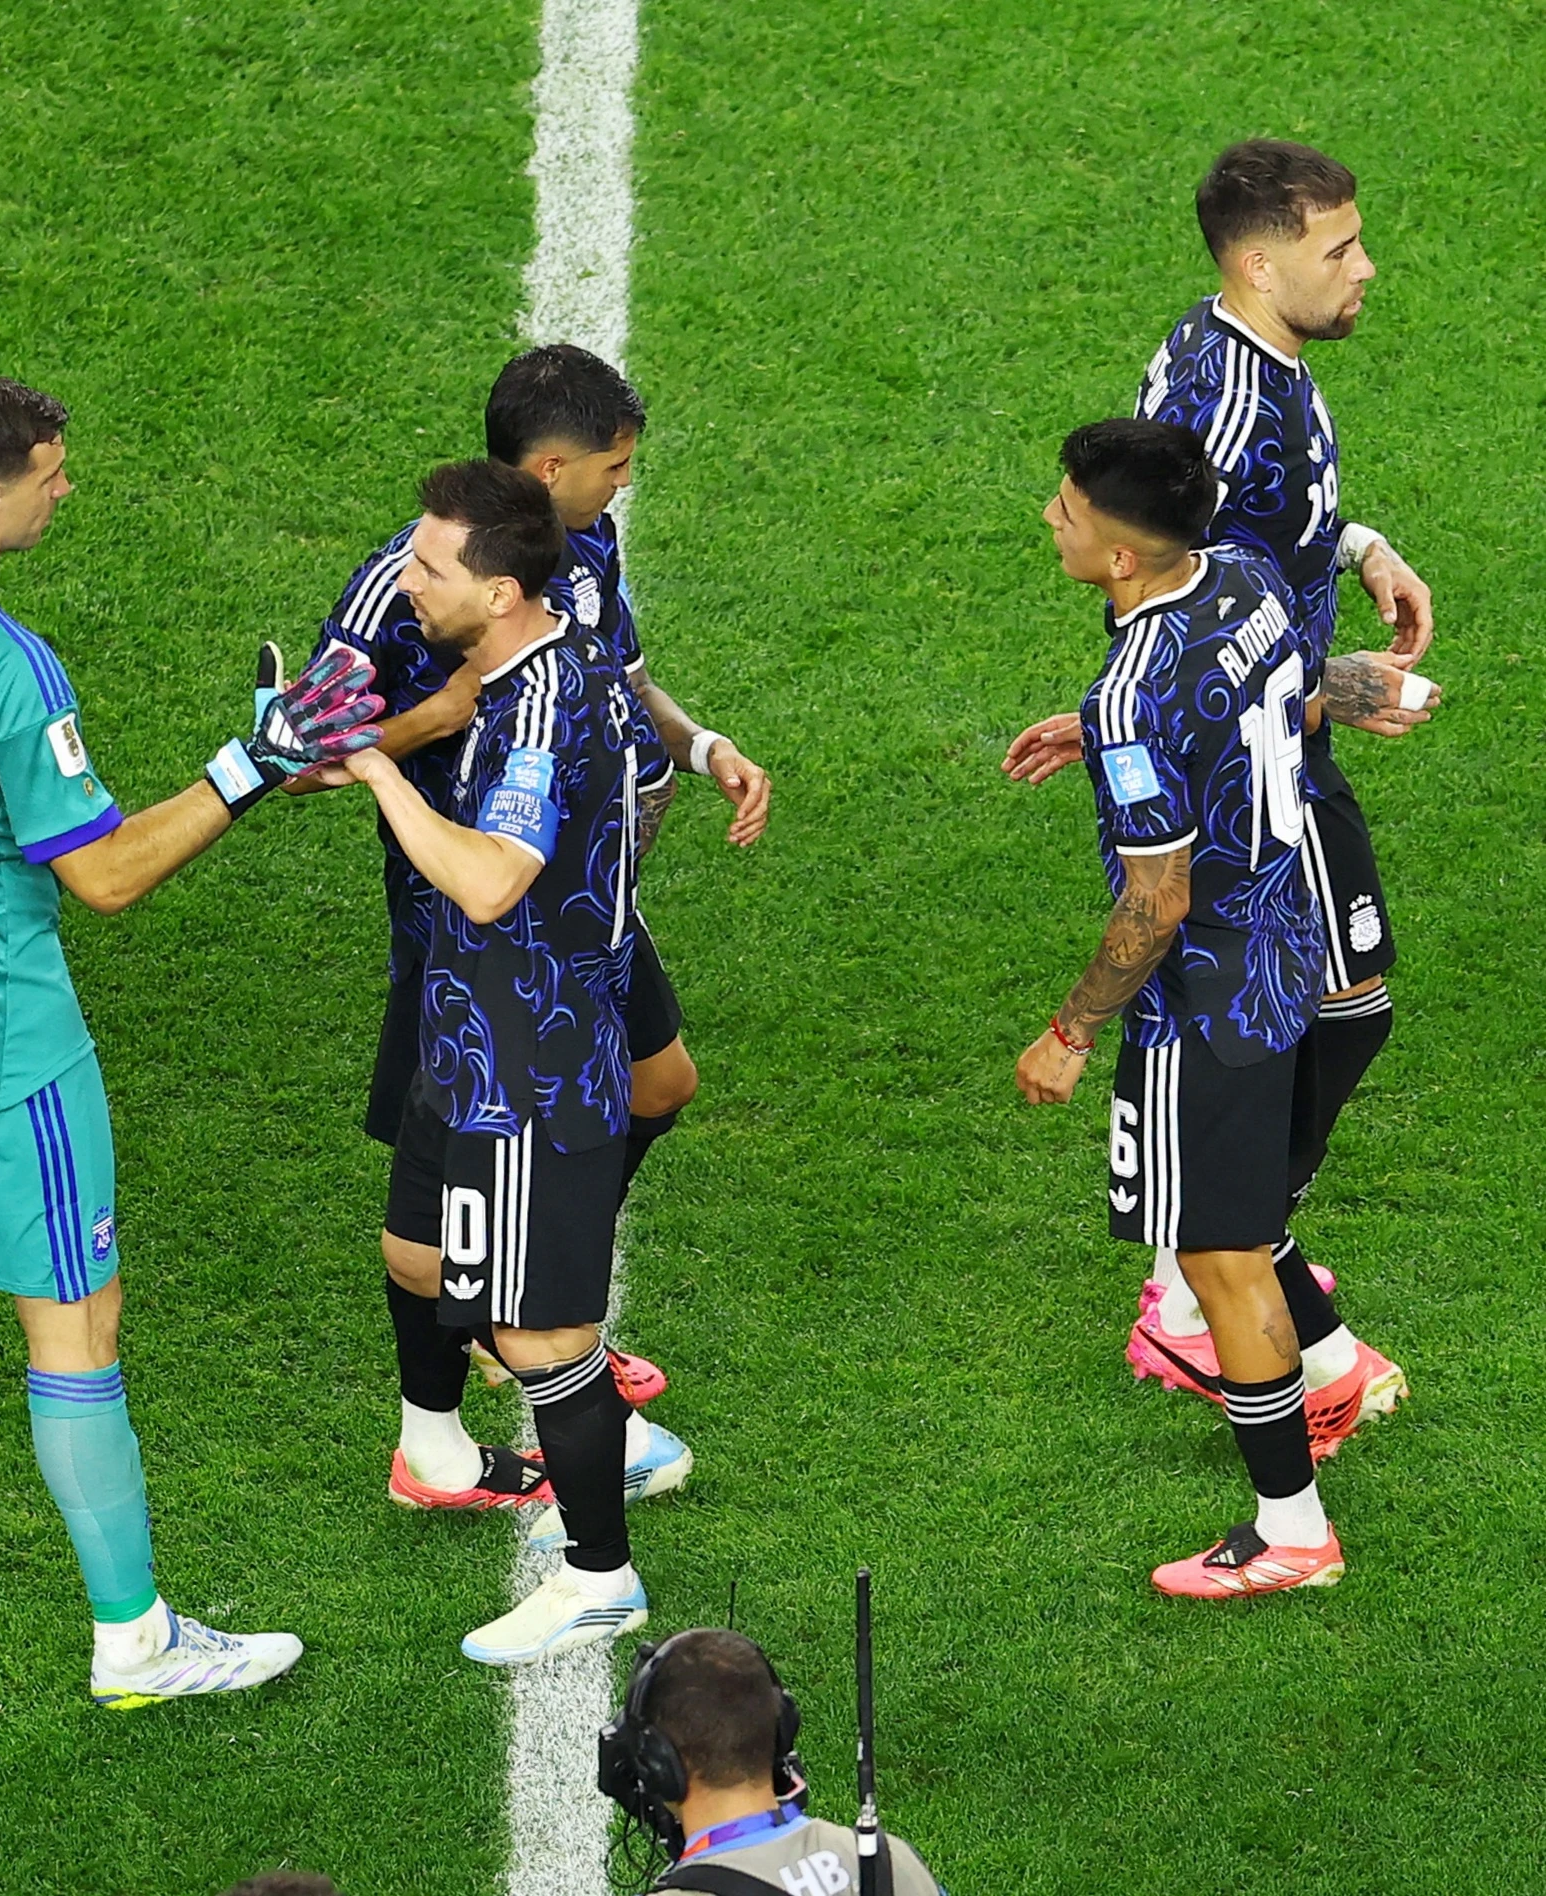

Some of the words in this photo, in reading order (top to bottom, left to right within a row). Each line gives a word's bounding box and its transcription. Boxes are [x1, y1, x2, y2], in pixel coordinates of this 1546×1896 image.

[1217, 591, 1290, 689] ALMADA
[491, 799, 541, 820] UNITES
[494, 790, 541, 810] FOOTBALL
[779, 1850, 850, 1896] HB
